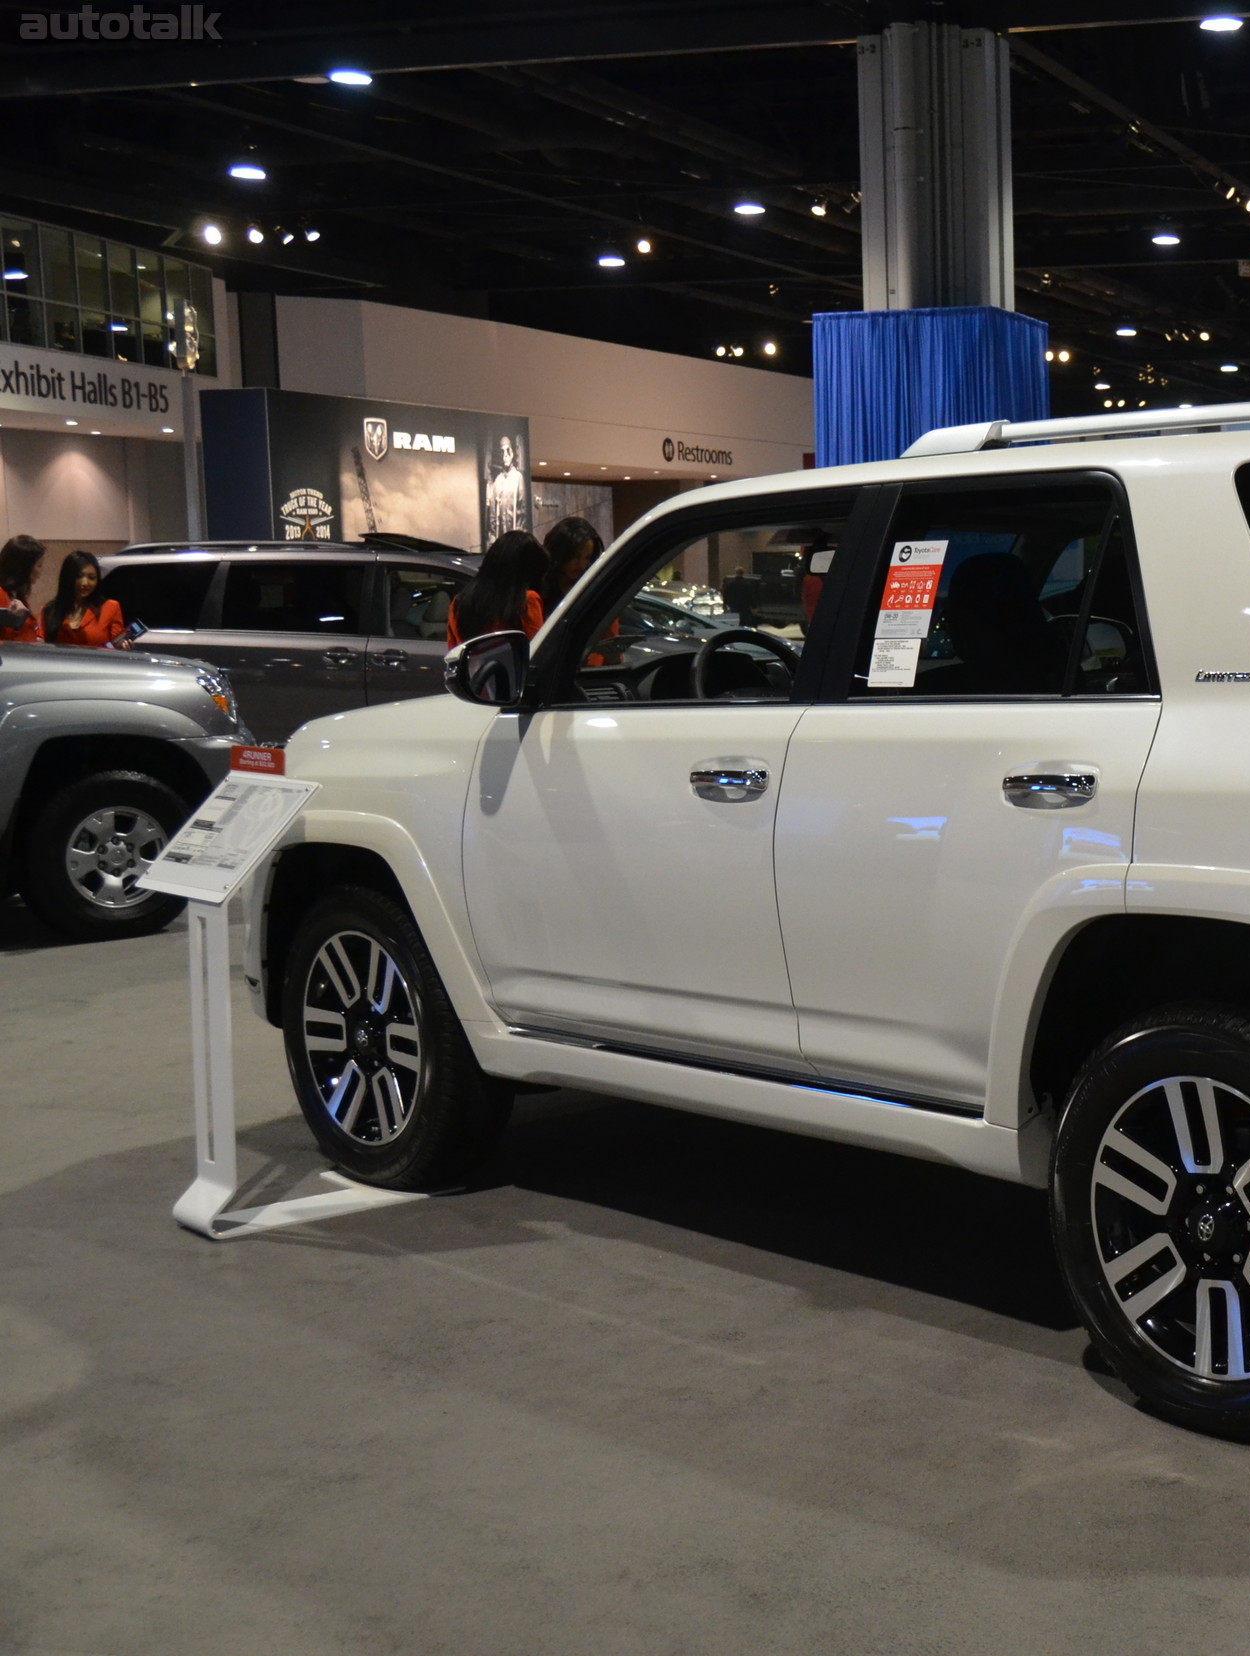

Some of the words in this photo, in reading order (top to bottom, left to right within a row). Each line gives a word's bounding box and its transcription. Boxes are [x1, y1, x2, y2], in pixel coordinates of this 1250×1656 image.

[0, 360, 66, 401] xhibit
[70, 370, 118, 407] Halls
[121, 378, 169, 413] B1-B5
[393, 431, 456, 454] RAM
[677, 441, 733, 466] Restrooms
[281, 498, 299, 516] TRUCK
[298, 496, 306, 507] OF
[307, 496, 318, 507] THE
[318, 499, 332, 516] YEAR
[285, 524, 302, 540] 2013
[315, 524, 331, 540] 2014
[243, 750, 272, 761] 4RUNNER
